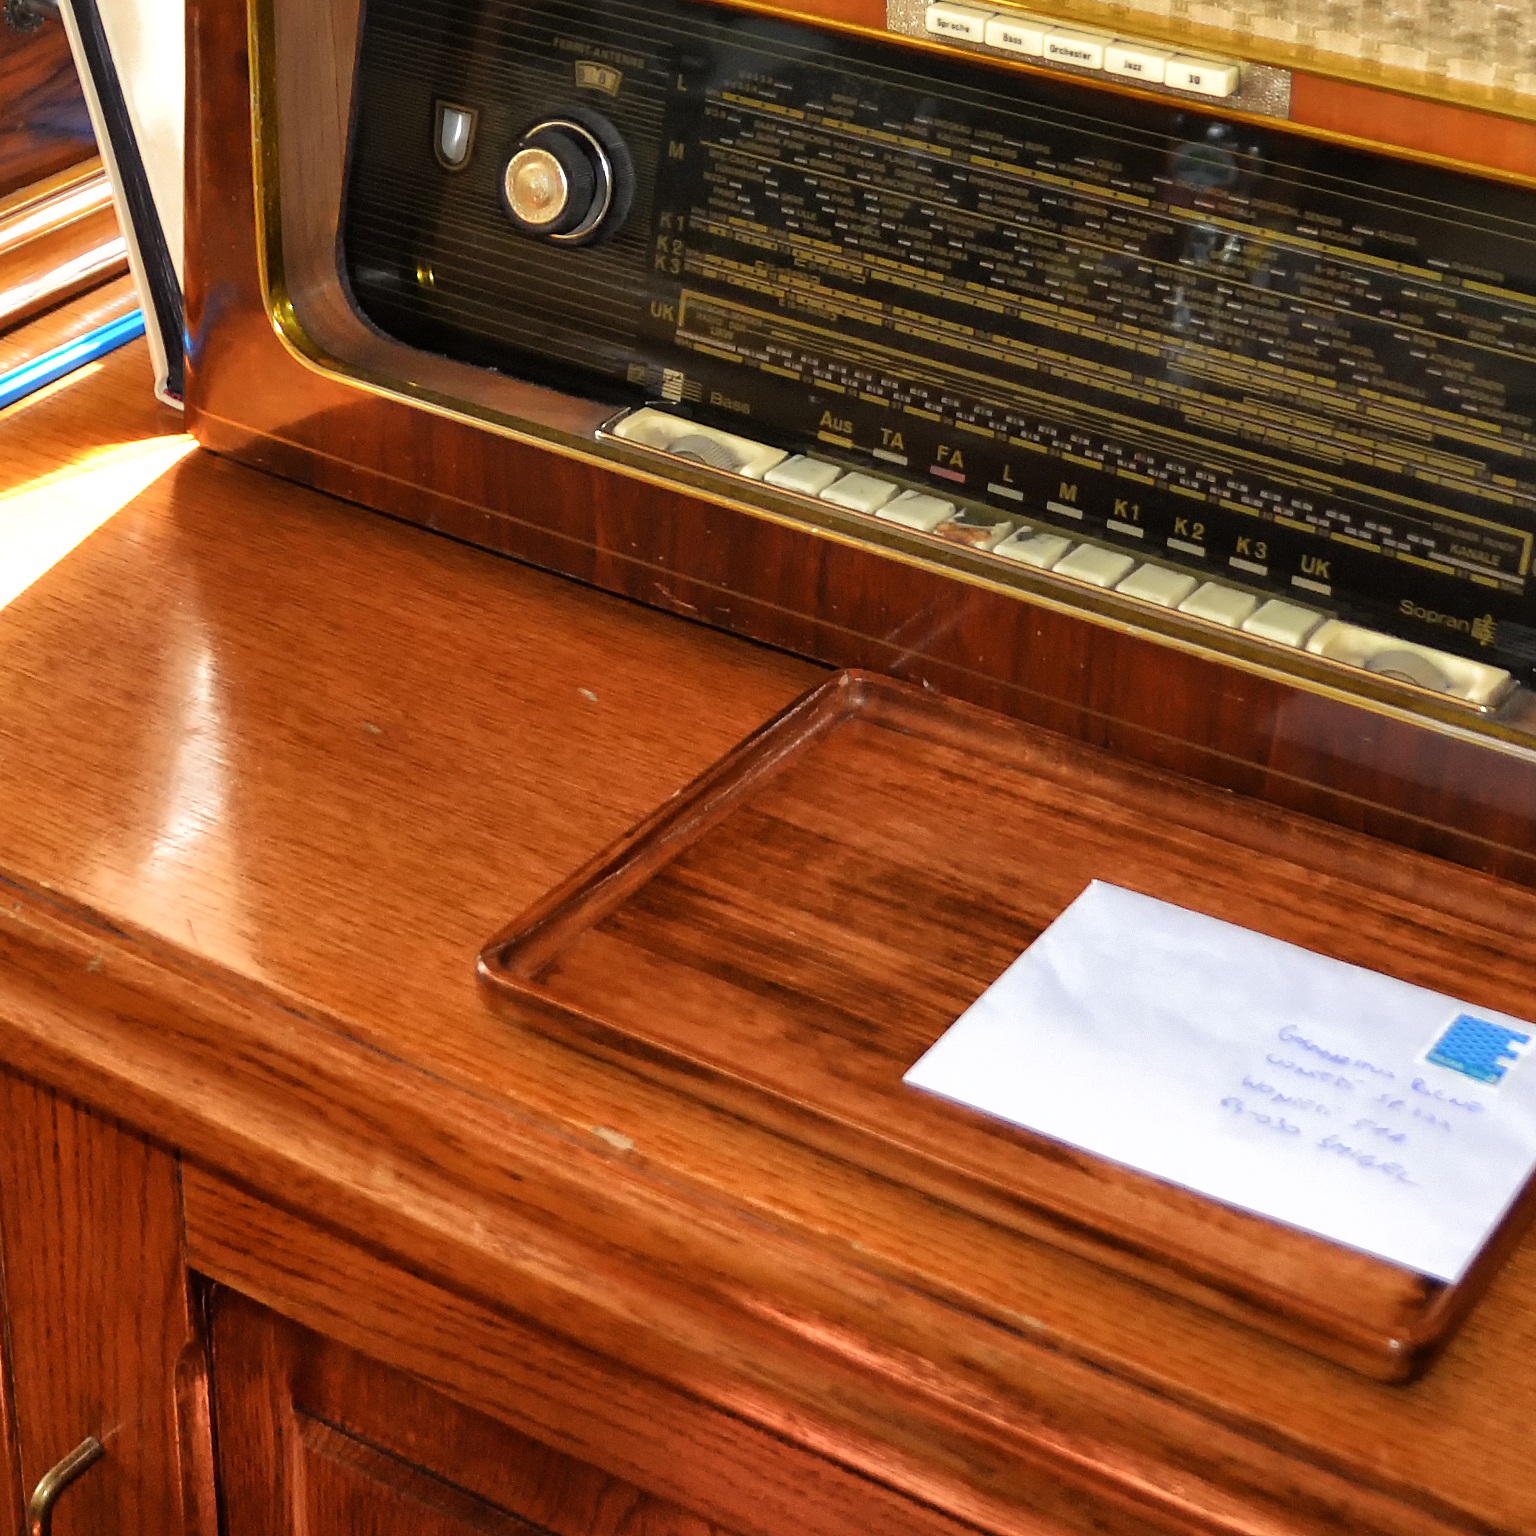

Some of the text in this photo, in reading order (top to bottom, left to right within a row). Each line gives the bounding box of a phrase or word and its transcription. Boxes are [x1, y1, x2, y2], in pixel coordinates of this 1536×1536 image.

[1002, 32, 1023, 46] Bass
[1049, 44, 1093, 61] Orchester
[677, 73, 688, 92] L
[668, 139, 686, 161] M
[650, 299, 675, 322] UK
[709, 390, 751, 414] Bass
[819, 409, 853, 435] Aus
[880, 426, 905, 451] TA
[936, 444, 964, 468] FA
[1003, 464, 1014, 483] L
[1058, 481, 1078, 503] M
[1300, 554, 1331, 579] UK
[1398, 598, 1471, 634] Sopran
